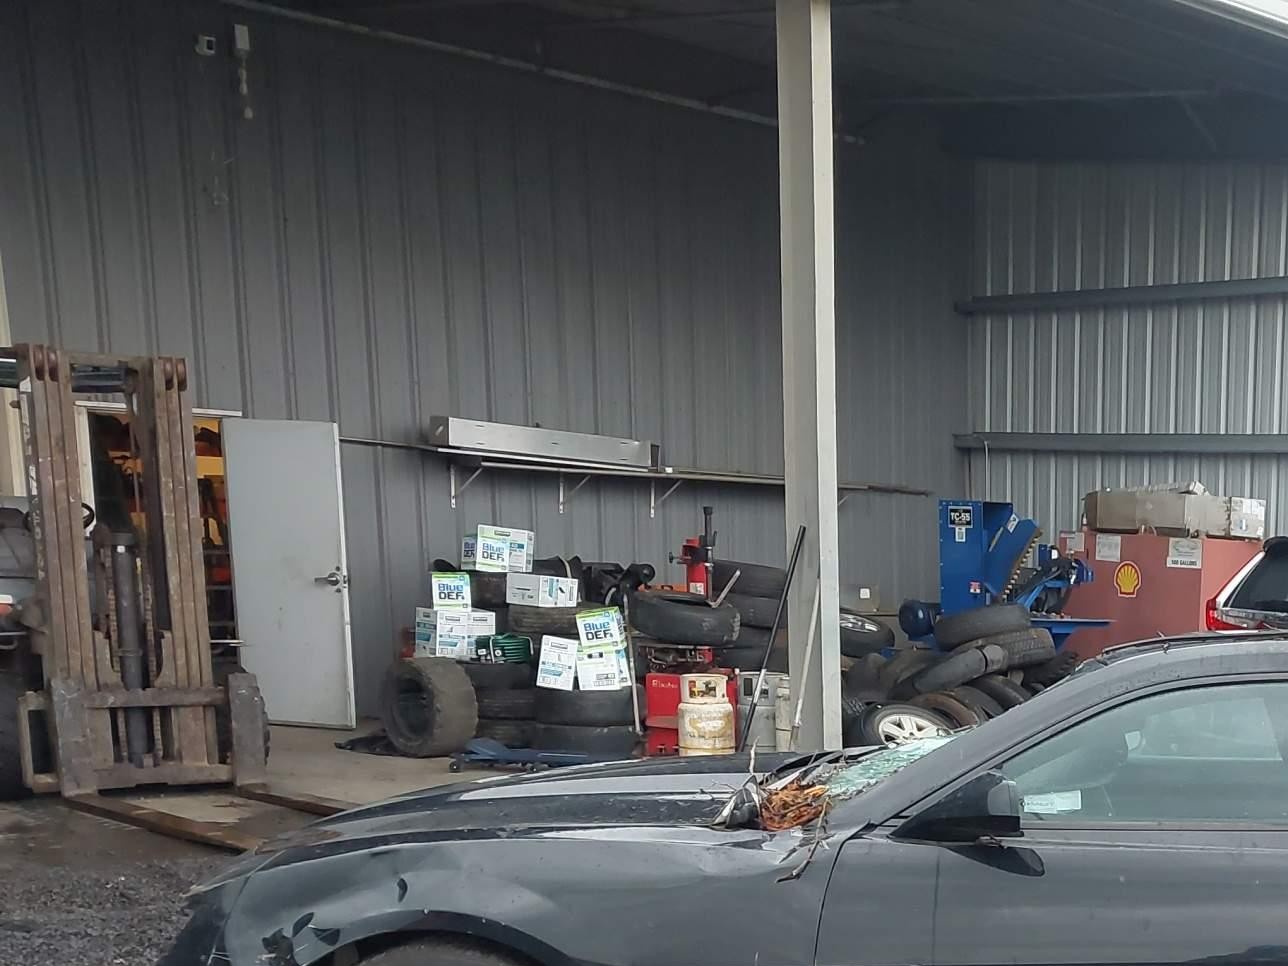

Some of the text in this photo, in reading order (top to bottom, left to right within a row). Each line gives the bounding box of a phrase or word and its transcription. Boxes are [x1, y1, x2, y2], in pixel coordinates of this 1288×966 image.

[950, 512, 971, 522] TC-55
[482, 542, 505, 553] Blue
[481, 551, 504, 562] DEF
[437, 583, 464, 592] Blue
[438, 591, 465, 600] DEF
[583, 621, 610, 632] Blue
[585, 630, 613, 641] DEF
